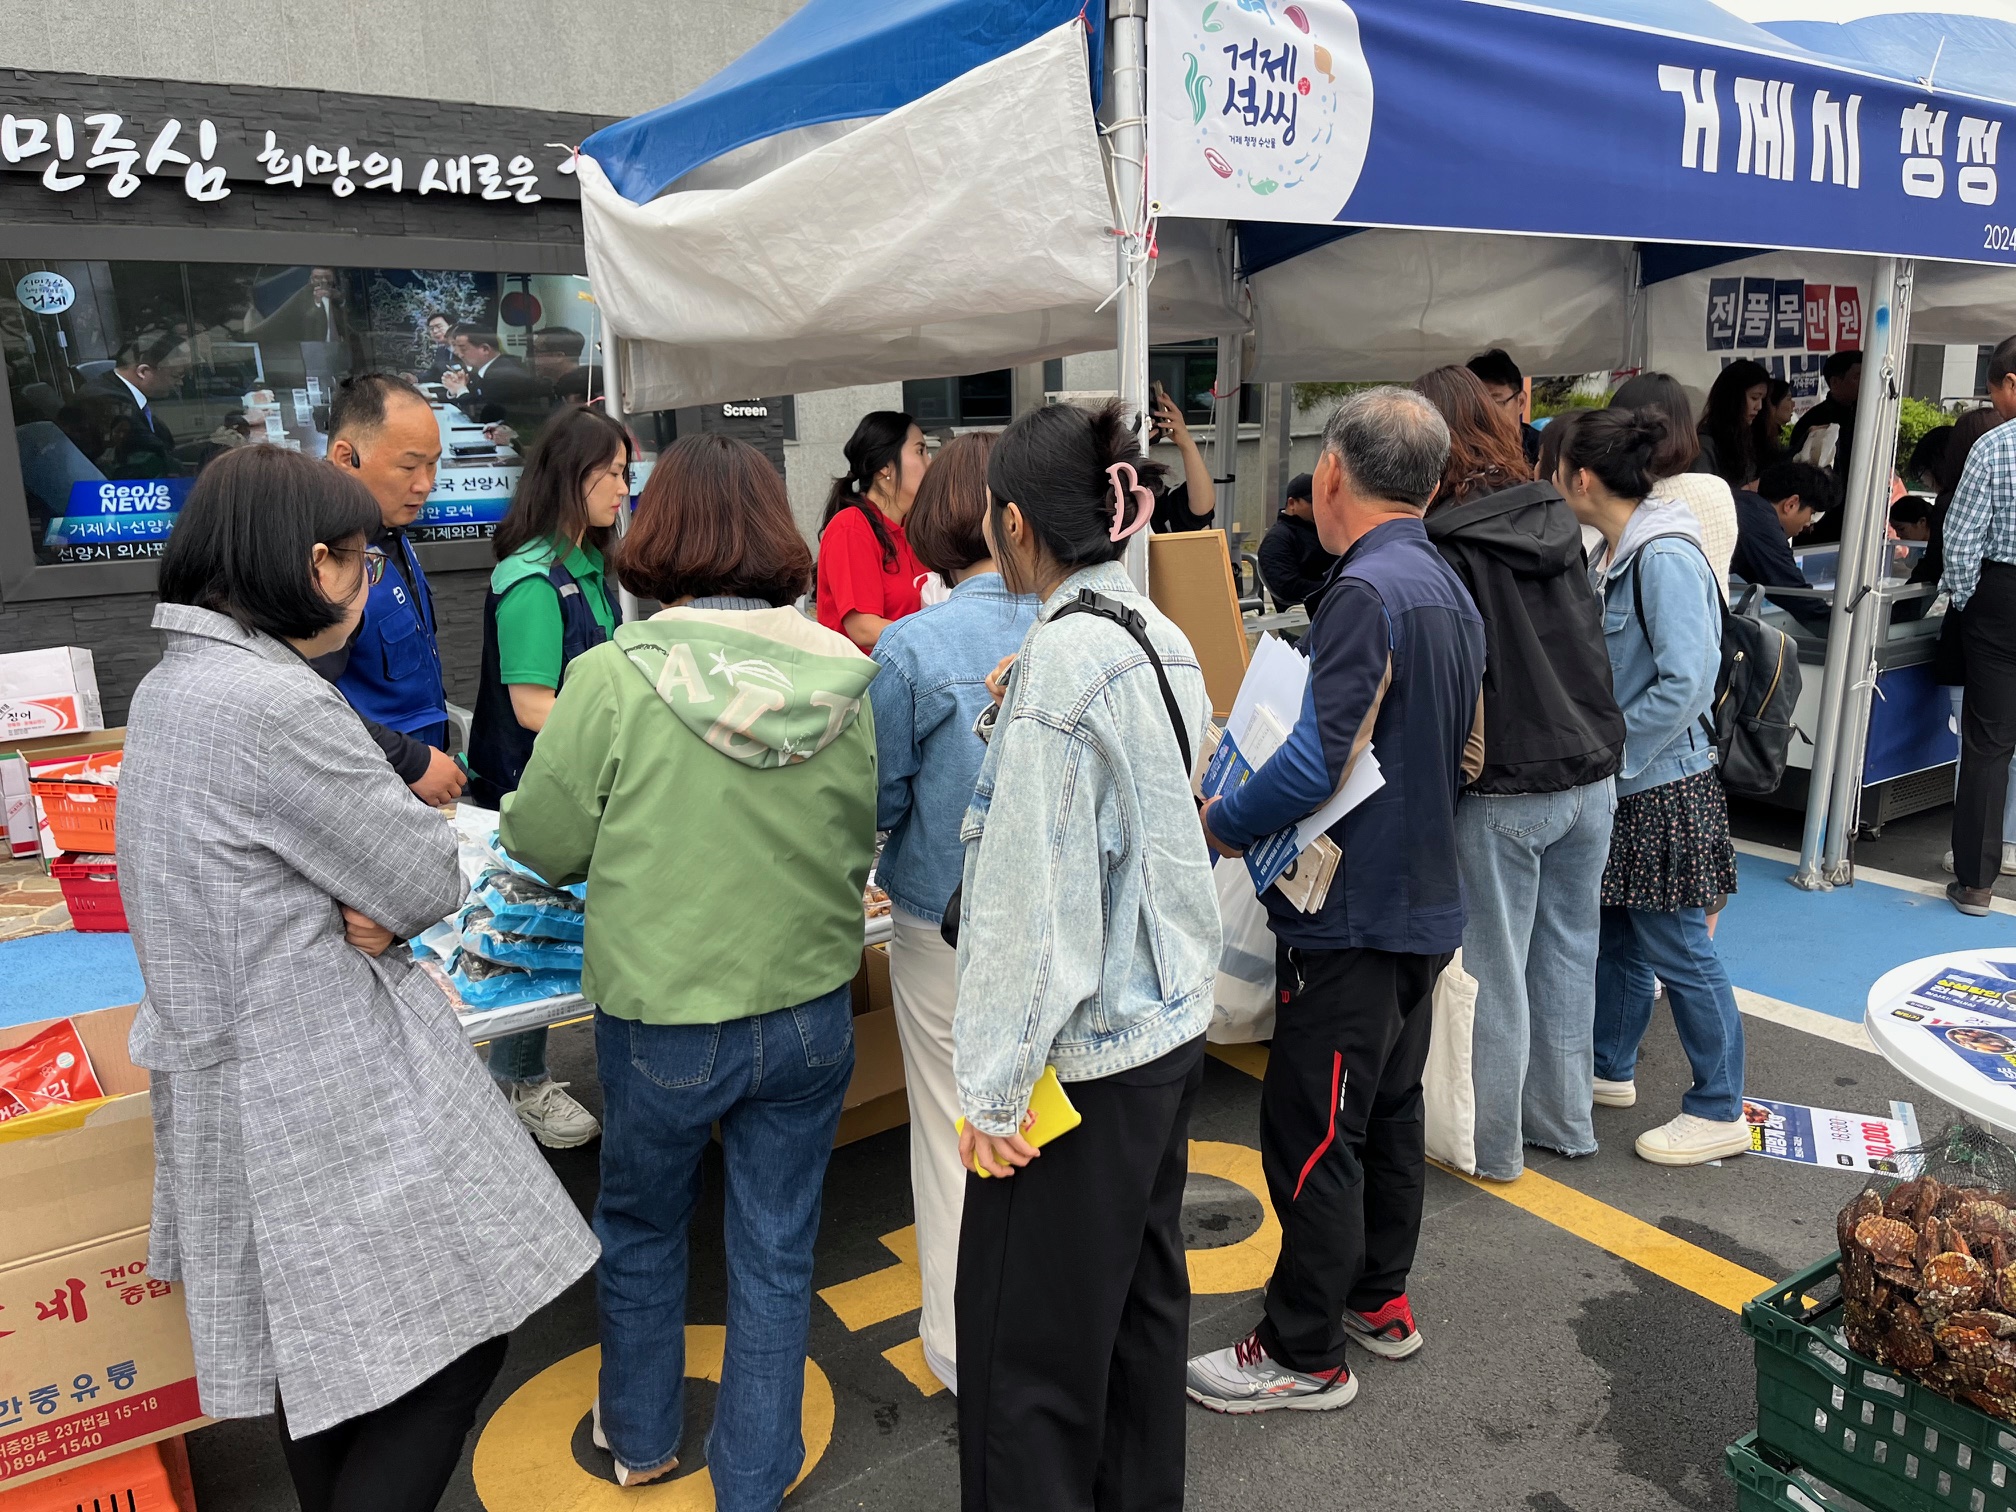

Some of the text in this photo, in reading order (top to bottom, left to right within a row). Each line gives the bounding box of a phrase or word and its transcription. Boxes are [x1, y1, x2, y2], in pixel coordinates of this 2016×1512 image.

[1223, 38, 1297, 84] 거제
[1222, 76, 1297, 146] 섬씽
[1658, 64, 2002, 206] 거제시 청정
[1, 113, 542, 203] 민중심 희망의 새로운
[723, 403, 768, 417] Screen
[99, 482, 169, 499] GeoJe
[462, 476, 509, 491] 선양시
[101, 496, 171, 513] NEWS
[445, 505, 474, 518] 모색
[58, 544, 111, 562] 선양시
[422, 526, 480, 540] 거제와의
[1256, 1375, 1295, 1389] Columbia
[55, 1410, 110, 1439] 237번길
[114, 1397, 158, 1420] 15-18
